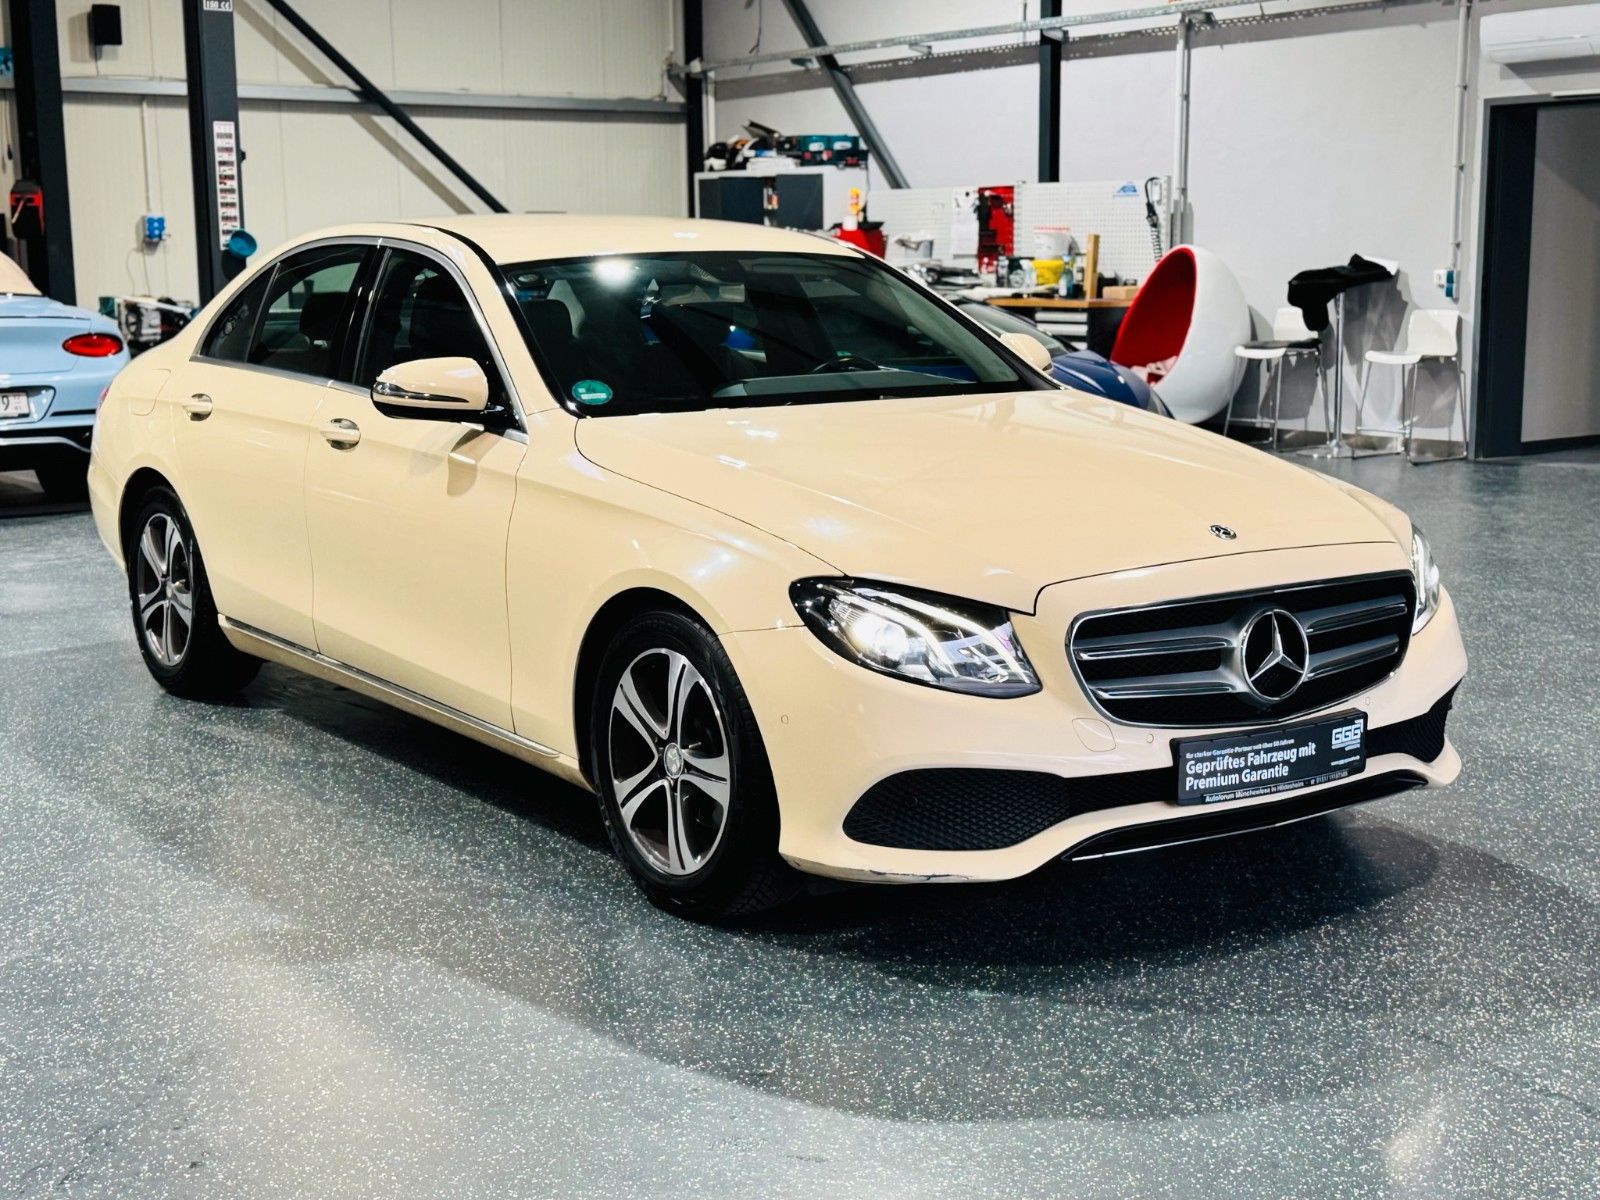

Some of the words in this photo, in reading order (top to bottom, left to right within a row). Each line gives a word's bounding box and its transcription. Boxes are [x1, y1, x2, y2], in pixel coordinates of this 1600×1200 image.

[1331, 722, 1361, 745] GGG
[1185, 755, 1246, 776] Geprüftes
[1247, 748, 1297, 767] Fahrzeug
[1298, 742, 1316, 758] mit
[1185, 772, 1240, 791] Premium
[1241, 763, 1289, 783] Garantie
